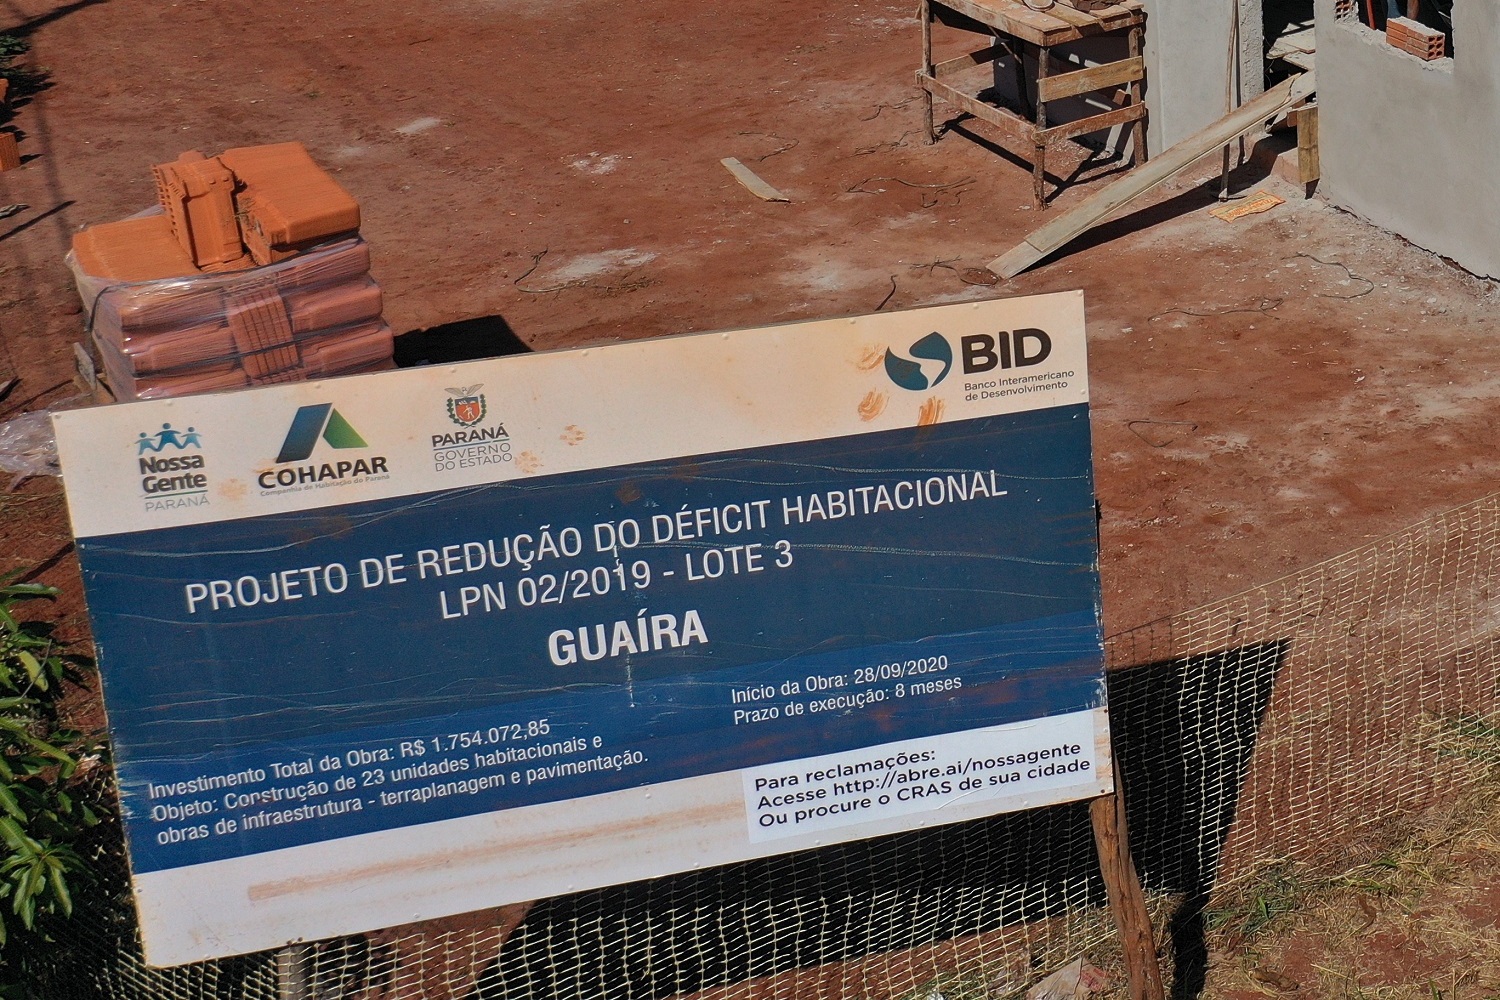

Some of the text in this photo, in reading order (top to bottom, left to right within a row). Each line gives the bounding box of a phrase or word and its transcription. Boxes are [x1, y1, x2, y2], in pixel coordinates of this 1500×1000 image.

[961, 328, 1051, 374] BID
[964, 370, 1074, 391] Banco Interamericano
[965, 381, 1068, 401] de Desenvolvimento
[432, 422, 509, 447] PARANÁ
[434, 442, 511, 462] GOVERNO
[139, 454, 204, 474] Nossa
[142, 472, 207, 493] Gente
[258, 457, 389, 489] COHAPAR
[435, 453, 513, 472] DO ESTADO
[145, 494, 210, 512] PARANÁ
[185, 469, 1008, 613] PROJETO DE REDUÇÃO DO DÉFICIT HABITACIONAL
[440, 581, 507, 620] LPN
[517, 559, 650, 607] 02/2019
[686, 544, 764, 581] LOTE
[774, 540, 793, 568] 3
[548, 608, 709, 666] GUAÍRA
[732, 655, 948, 704] Início da Obra: 28/09/2020
[734, 676, 962, 725] Prazo de execução: 8 meses
[149, 719, 550, 800] Investimento Total da Obra: R$ 1.754.072,85
[153, 735, 602, 822] Objeto: Construção de 23 unidades habitacionais e
[755, 750, 936, 791] Para reclamações:
[757, 744, 1081, 810] Acesse http://abre.ai/nossagente
[157, 823, 209, 846] obras
[215, 818, 237, 835] de
[242, 797, 363, 830] infraestrutura
[380, 773, 505, 806] terraplanagem
[511, 771, 521, 784] e
[526, 750, 649, 785] pavimentação.
[759, 759, 1090, 827] Ou procure o CRAS de sua cidade
